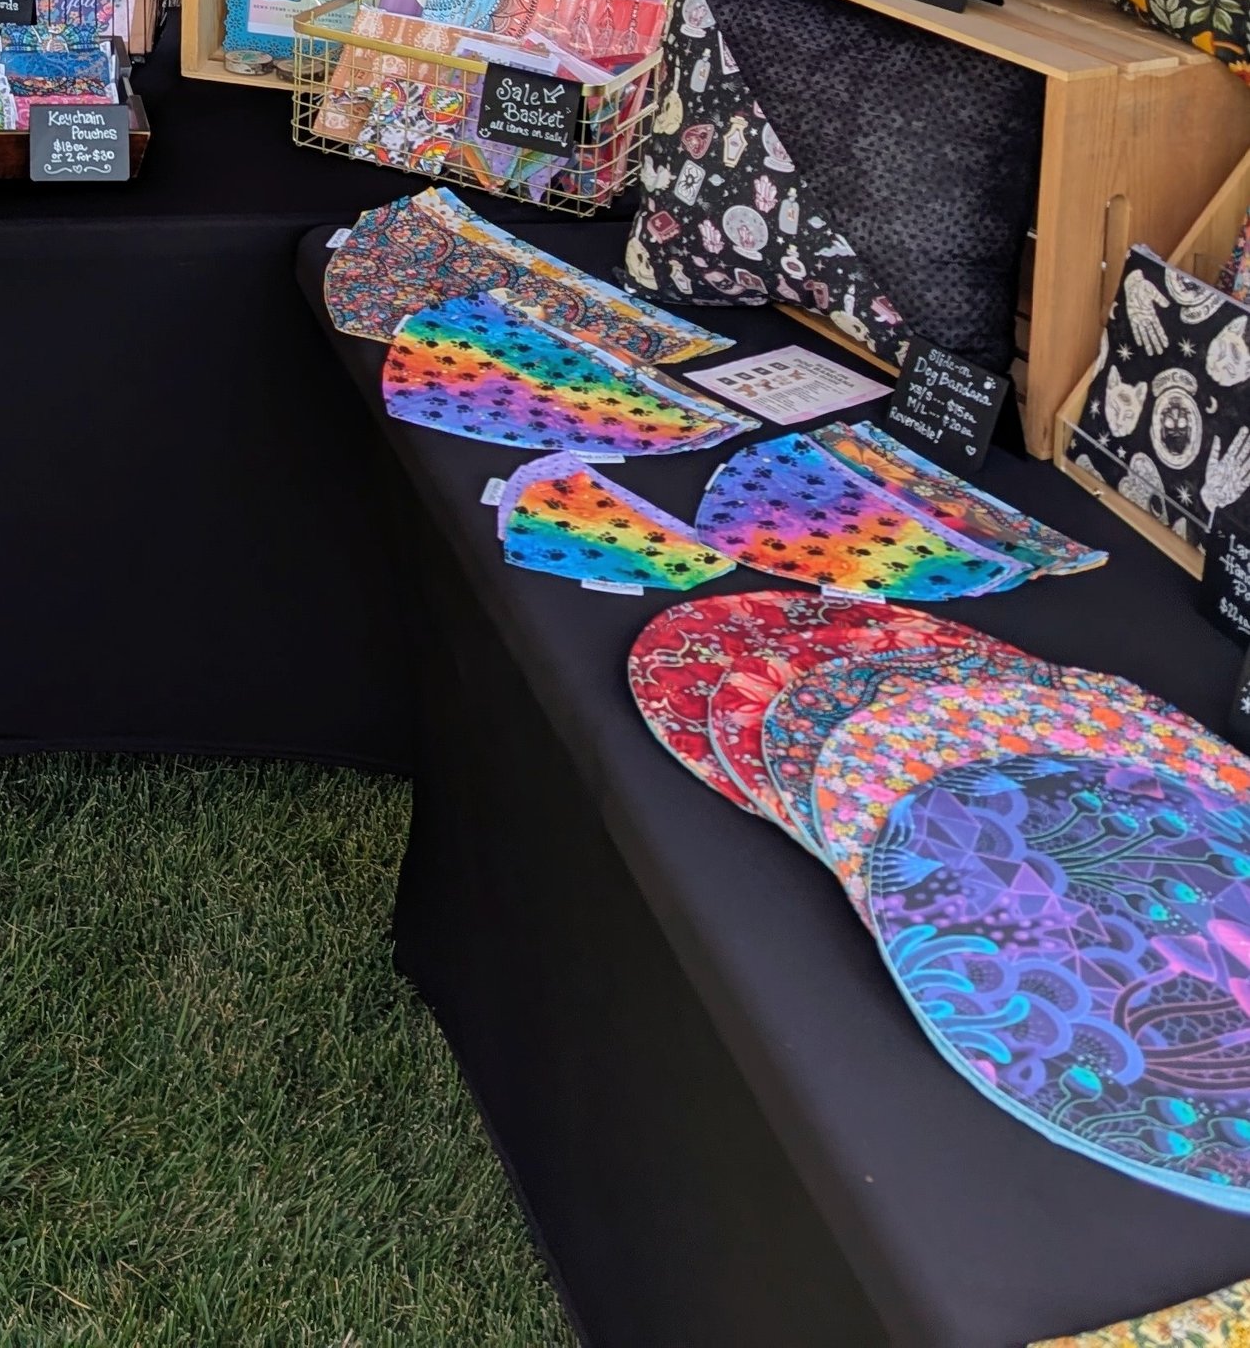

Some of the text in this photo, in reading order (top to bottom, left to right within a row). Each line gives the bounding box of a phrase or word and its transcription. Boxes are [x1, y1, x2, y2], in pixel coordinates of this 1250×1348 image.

[496, 77, 541, 105] Sale
[48, 110, 105, 126] Keychain
[502, 102, 565, 129] Basket
[71, 125, 117, 140] Pouches
[490, 120, 568, 148] all items on sale!
[51, 149, 115, 163] or 2 for $30
[929, 349, 973, 378] Slide-on
[914, 355, 993, 407] Dog Bandana
[889, 406, 943, 443] Reversible!
[1229, 533, 1250, 560] La
